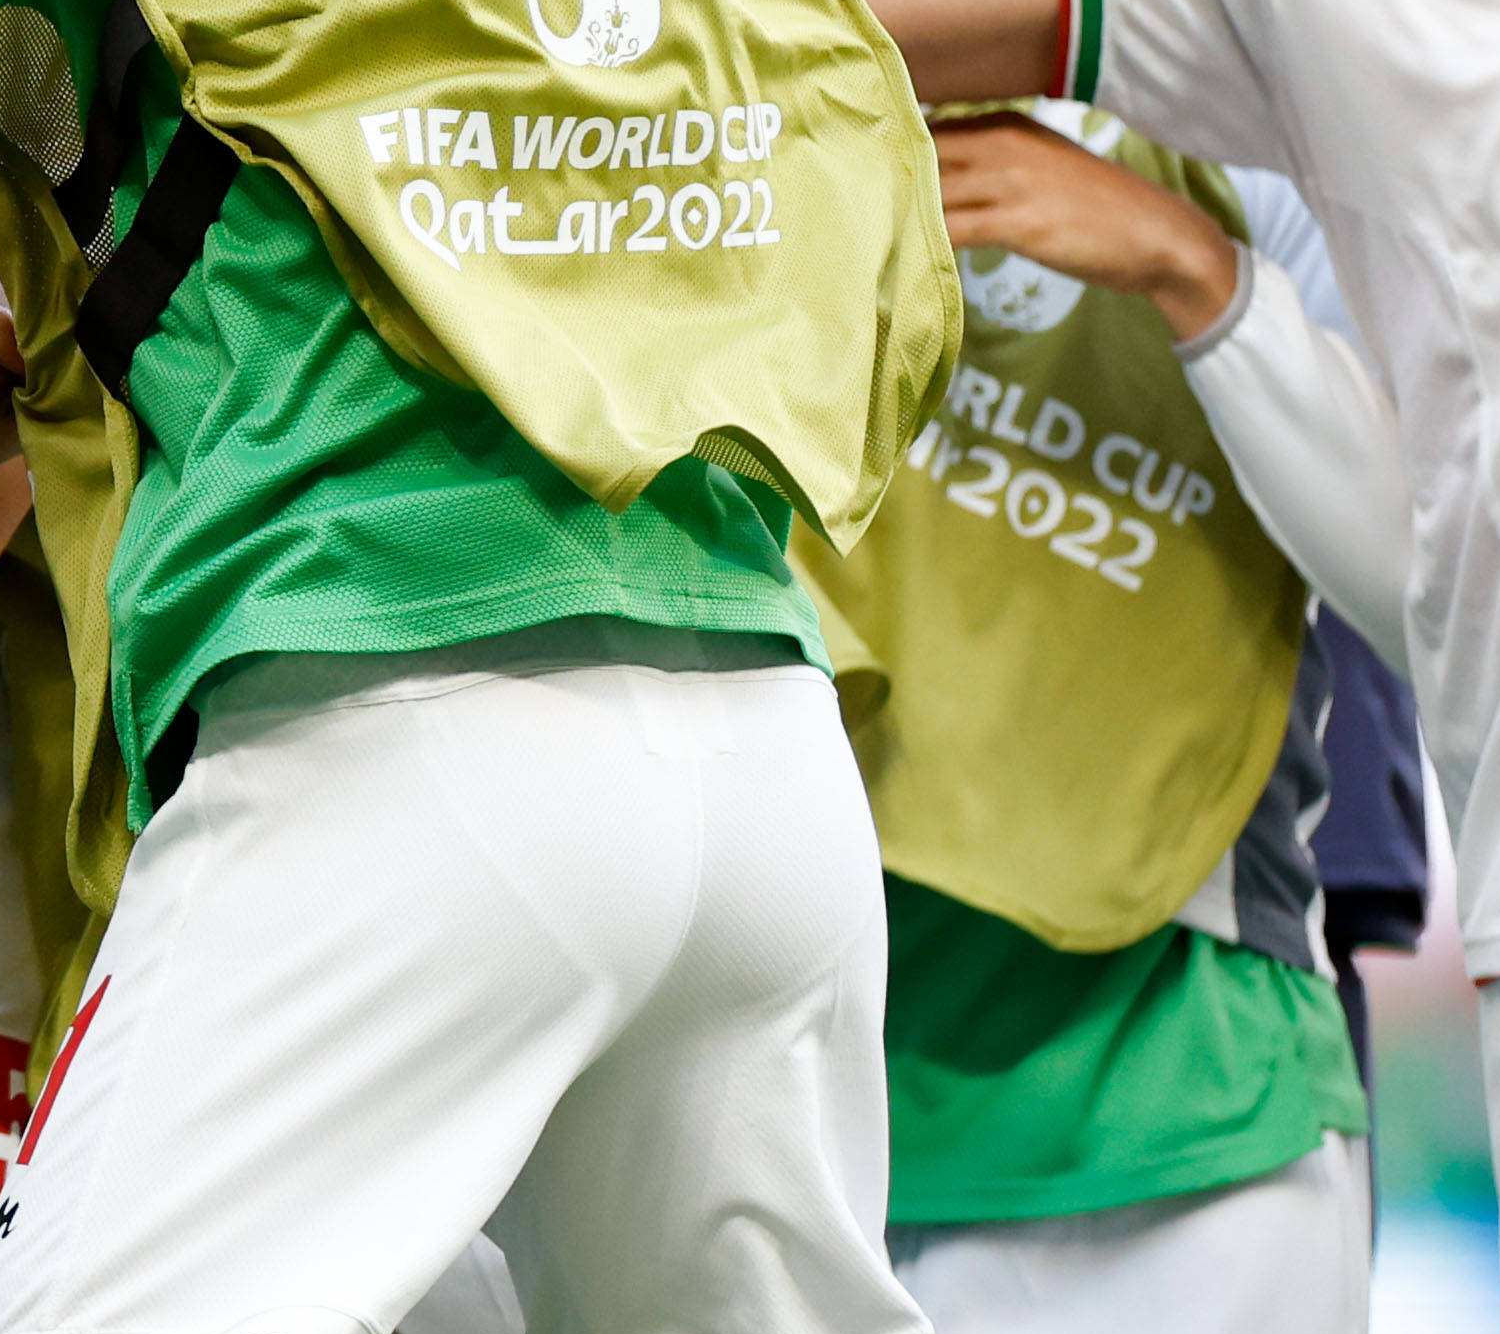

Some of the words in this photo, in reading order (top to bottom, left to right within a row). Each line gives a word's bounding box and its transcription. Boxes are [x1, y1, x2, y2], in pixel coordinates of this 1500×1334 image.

[358, 108, 497, 169] FIFA
[512, 109, 715, 170] WORLD
[721, 102, 783, 163] CUP
[1092, 433, 1216, 526] CUP
